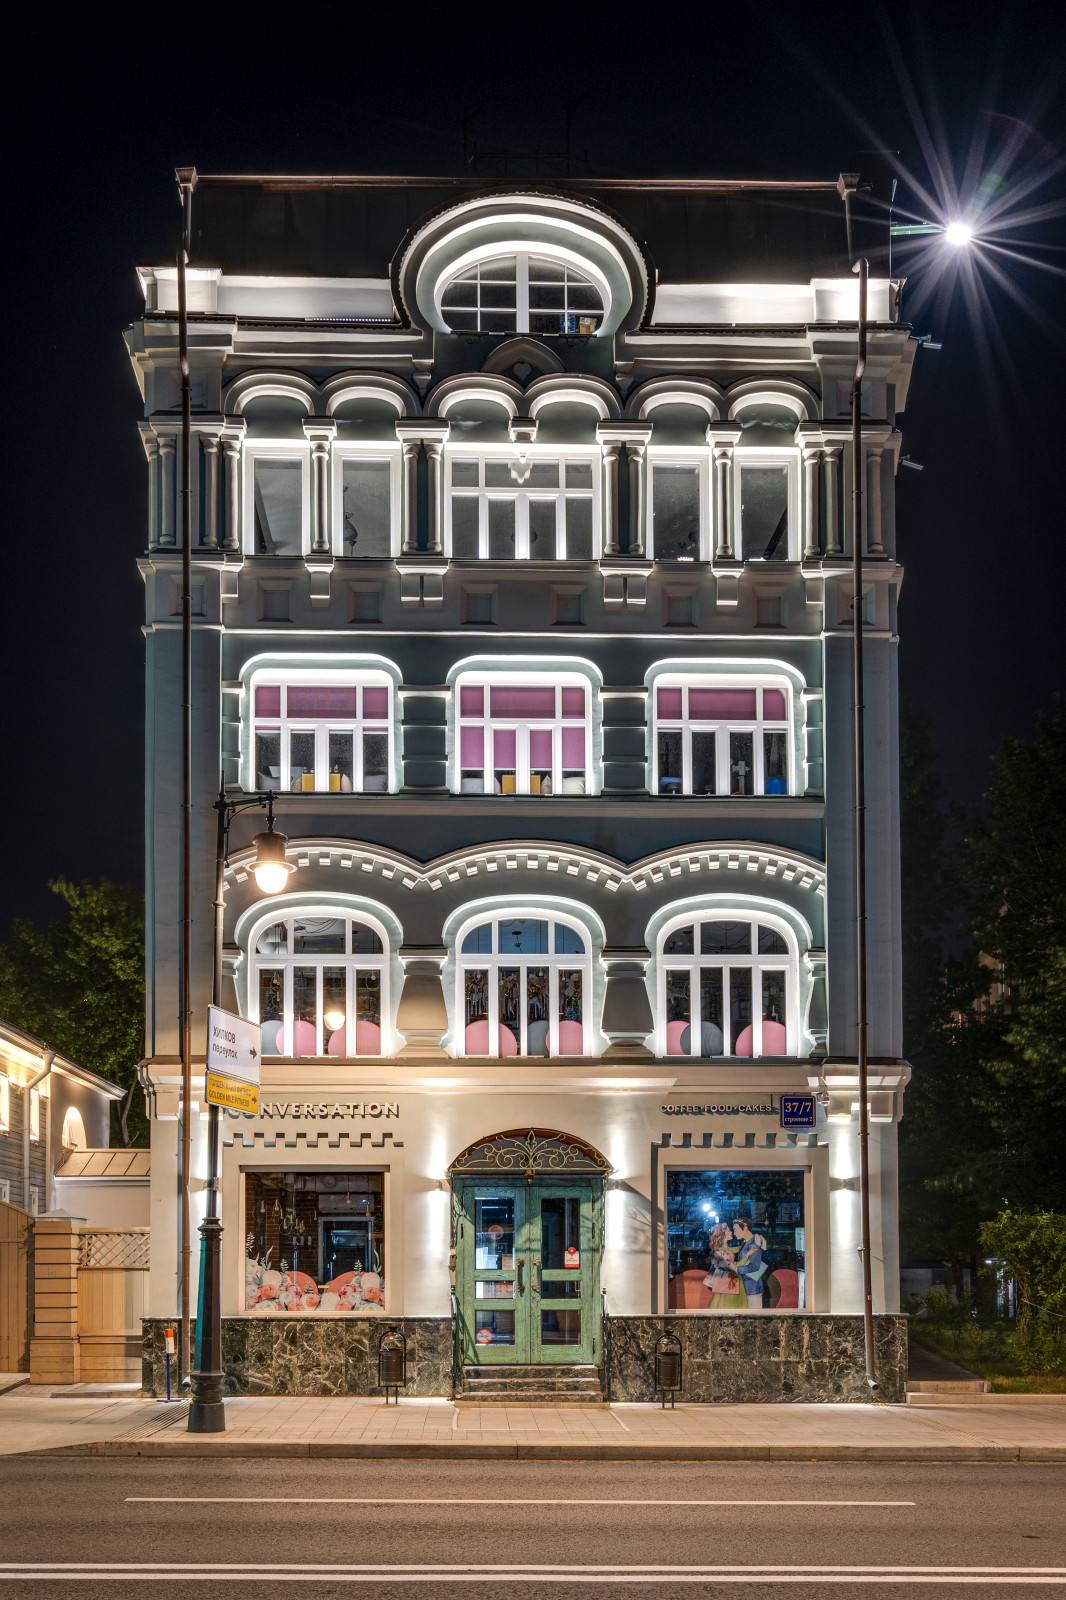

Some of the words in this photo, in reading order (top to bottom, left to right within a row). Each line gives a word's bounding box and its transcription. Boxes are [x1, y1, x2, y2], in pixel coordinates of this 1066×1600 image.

[213, 1043, 238, 1059] переулок
[209, 1090, 225, 1101] GOLDEN
[225, 1094, 235, 1103] MILE
[235, 1098, 250, 1107] FITNESS
[228, 1102, 399, 1117] NVERSATION
[785, 1101, 812, 1115] 37/7
